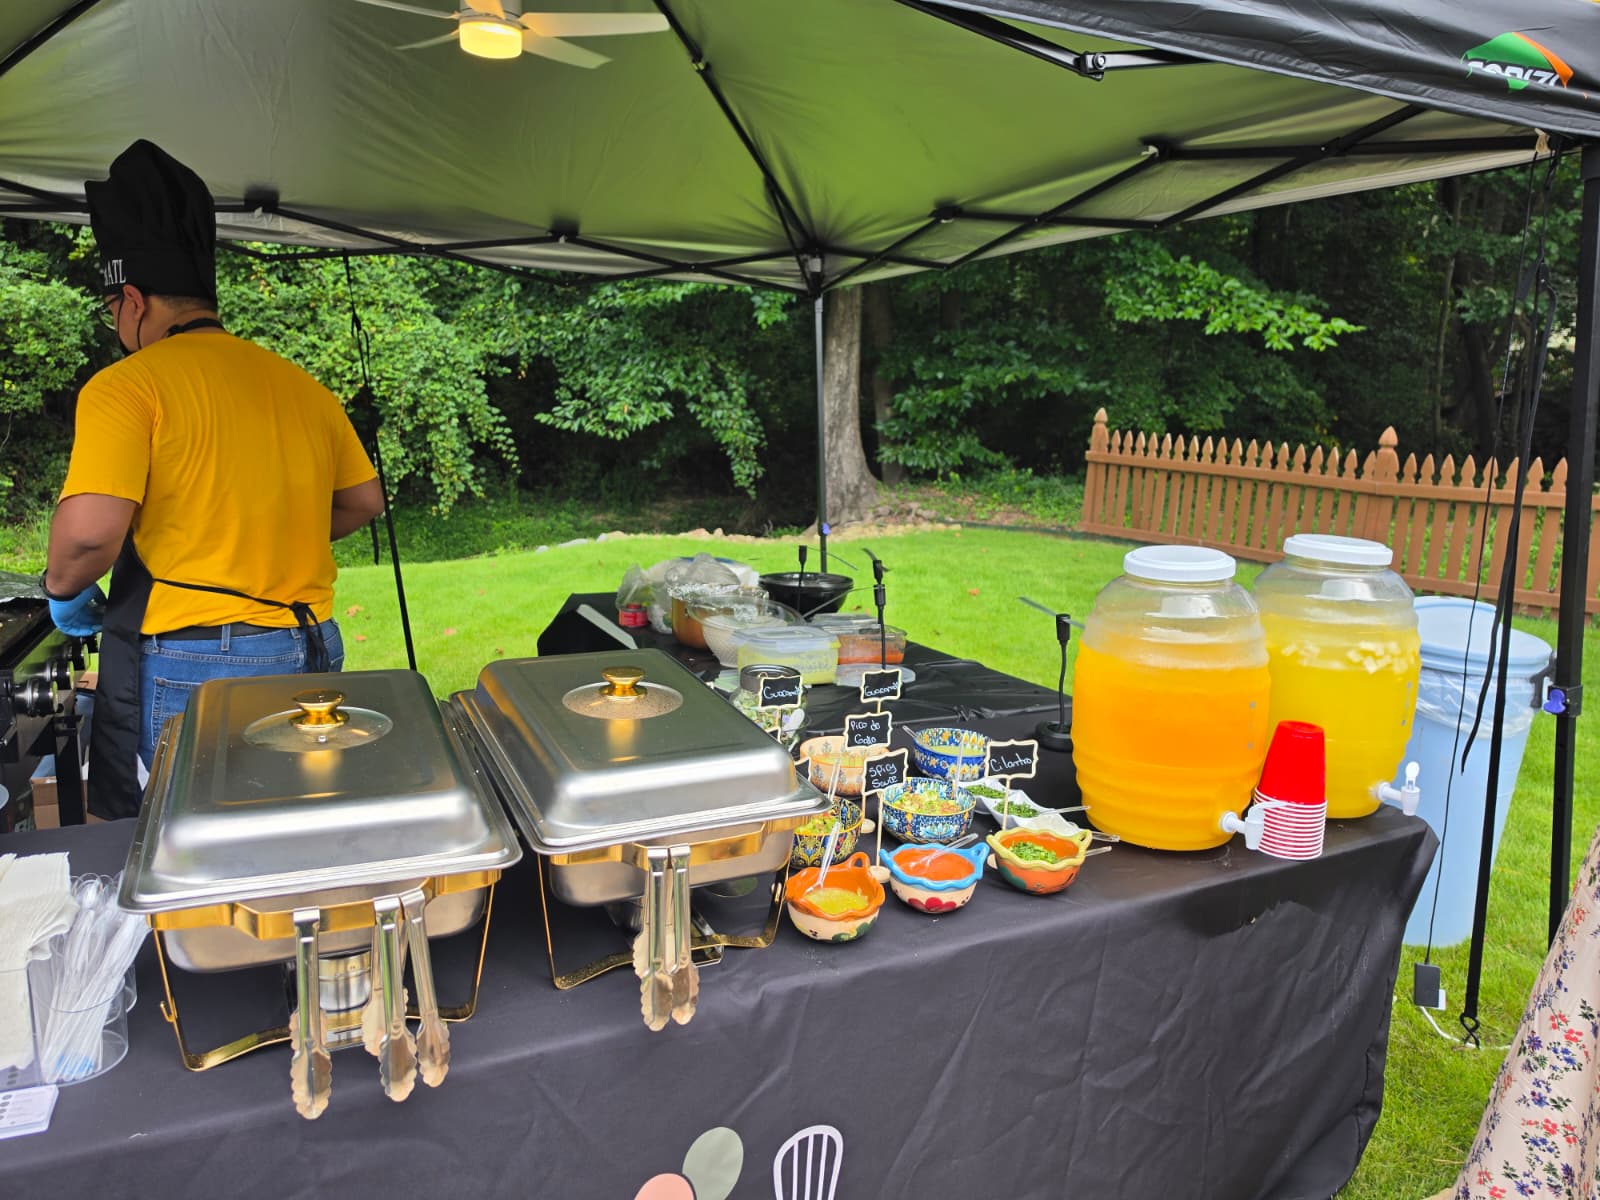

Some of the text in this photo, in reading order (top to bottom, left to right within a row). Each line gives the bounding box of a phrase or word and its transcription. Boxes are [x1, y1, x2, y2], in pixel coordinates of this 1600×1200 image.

[850, 719, 881, 731] Pico de
[990, 752, 1033, 772] Cilantro
